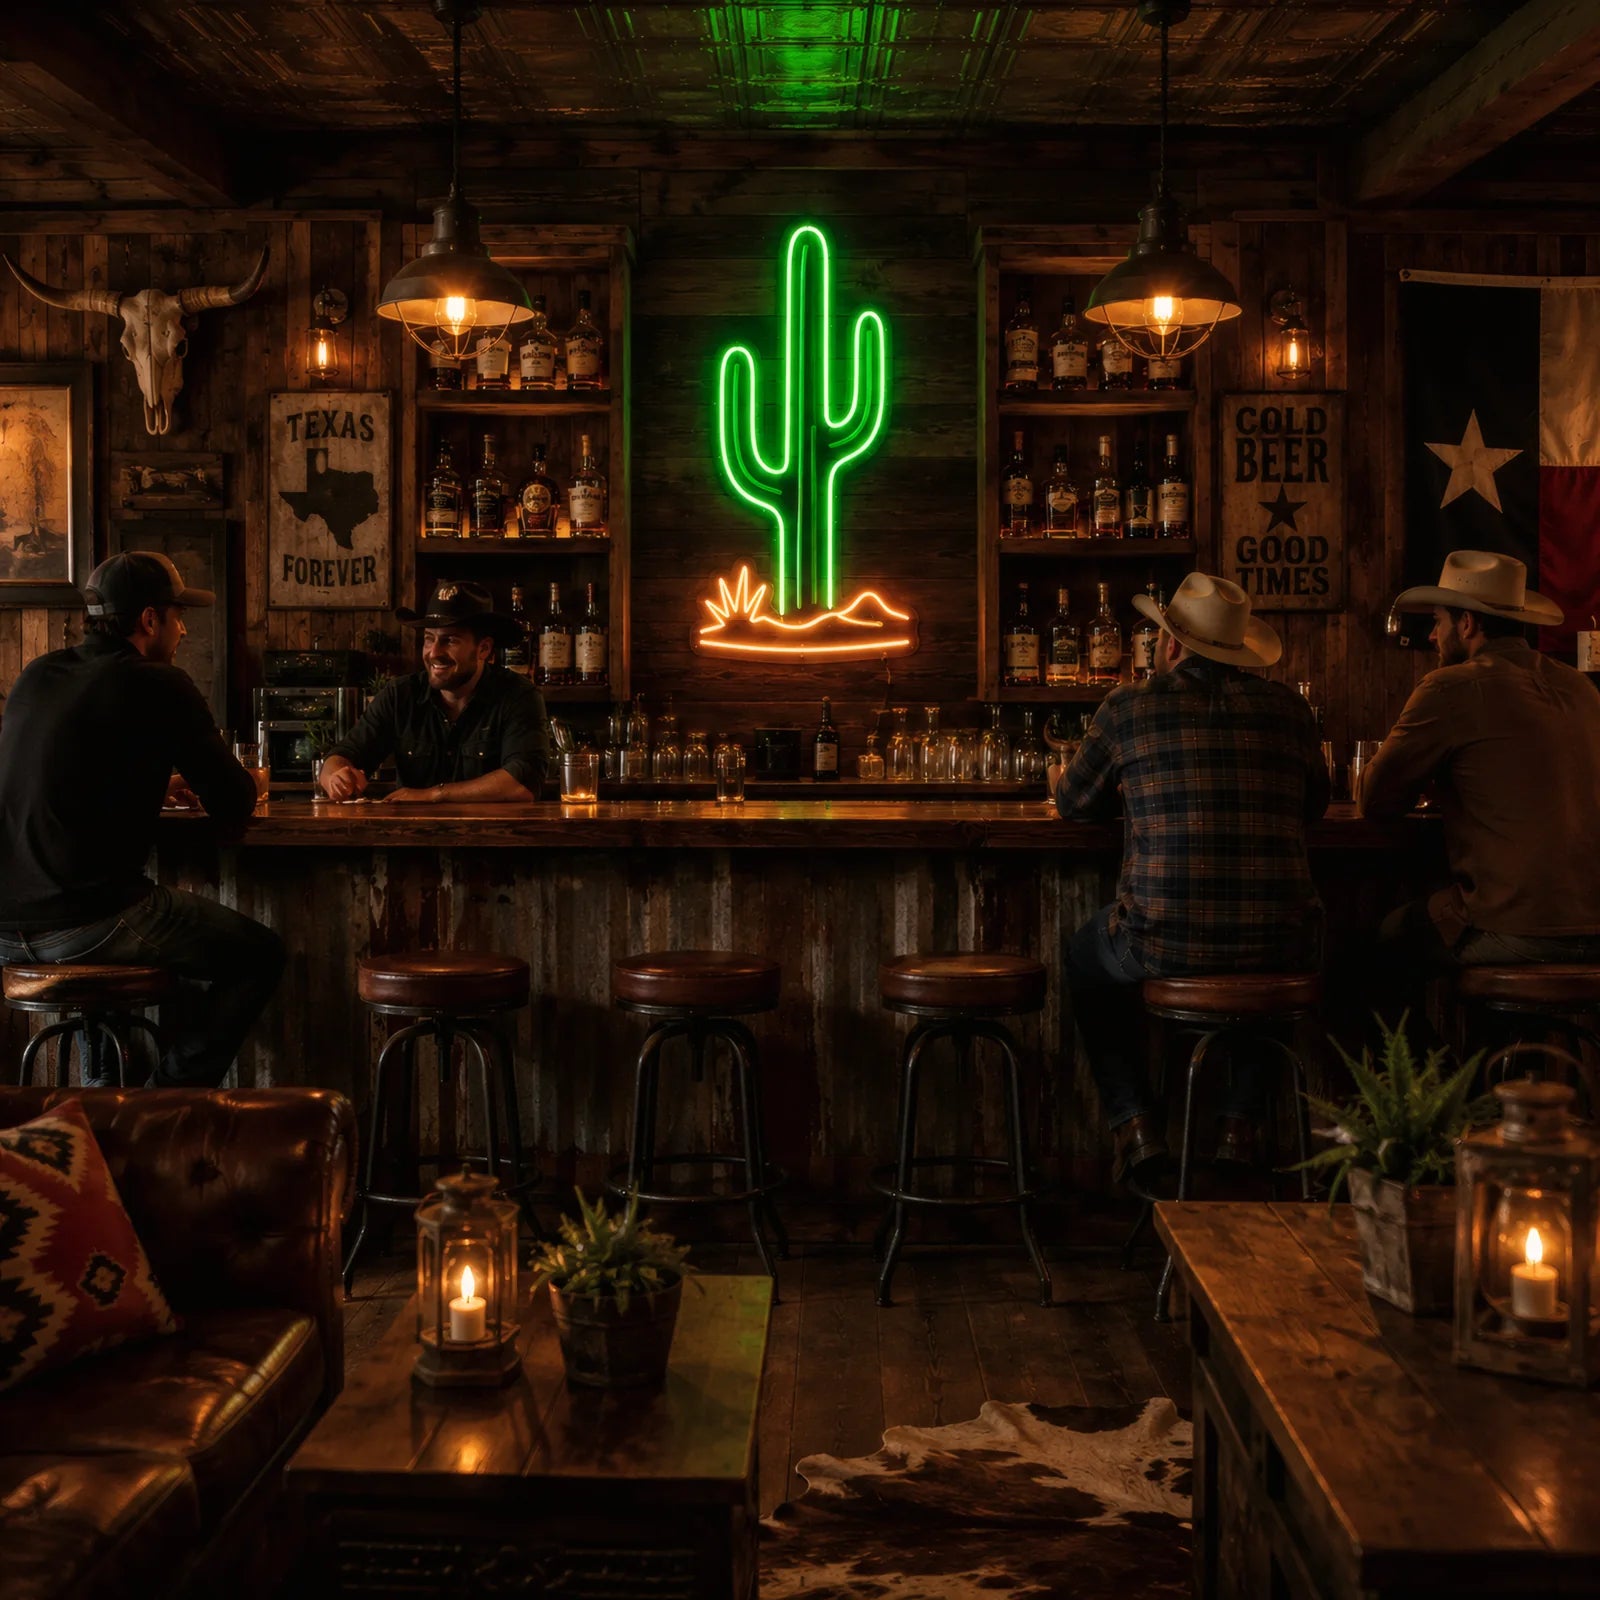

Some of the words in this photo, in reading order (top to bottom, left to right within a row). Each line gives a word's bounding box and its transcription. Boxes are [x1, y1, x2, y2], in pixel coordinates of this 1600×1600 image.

[286, 410, 375, 443] TEXAS
[1235, 407, 1328, 435] COLD
[1235, 437, 1330, 483] BEER
[1236, 535, 1329, 565] GOOD
[282, 554, 377, 588] FOREVER
[1235, 567, 1330, 596] TIMES
